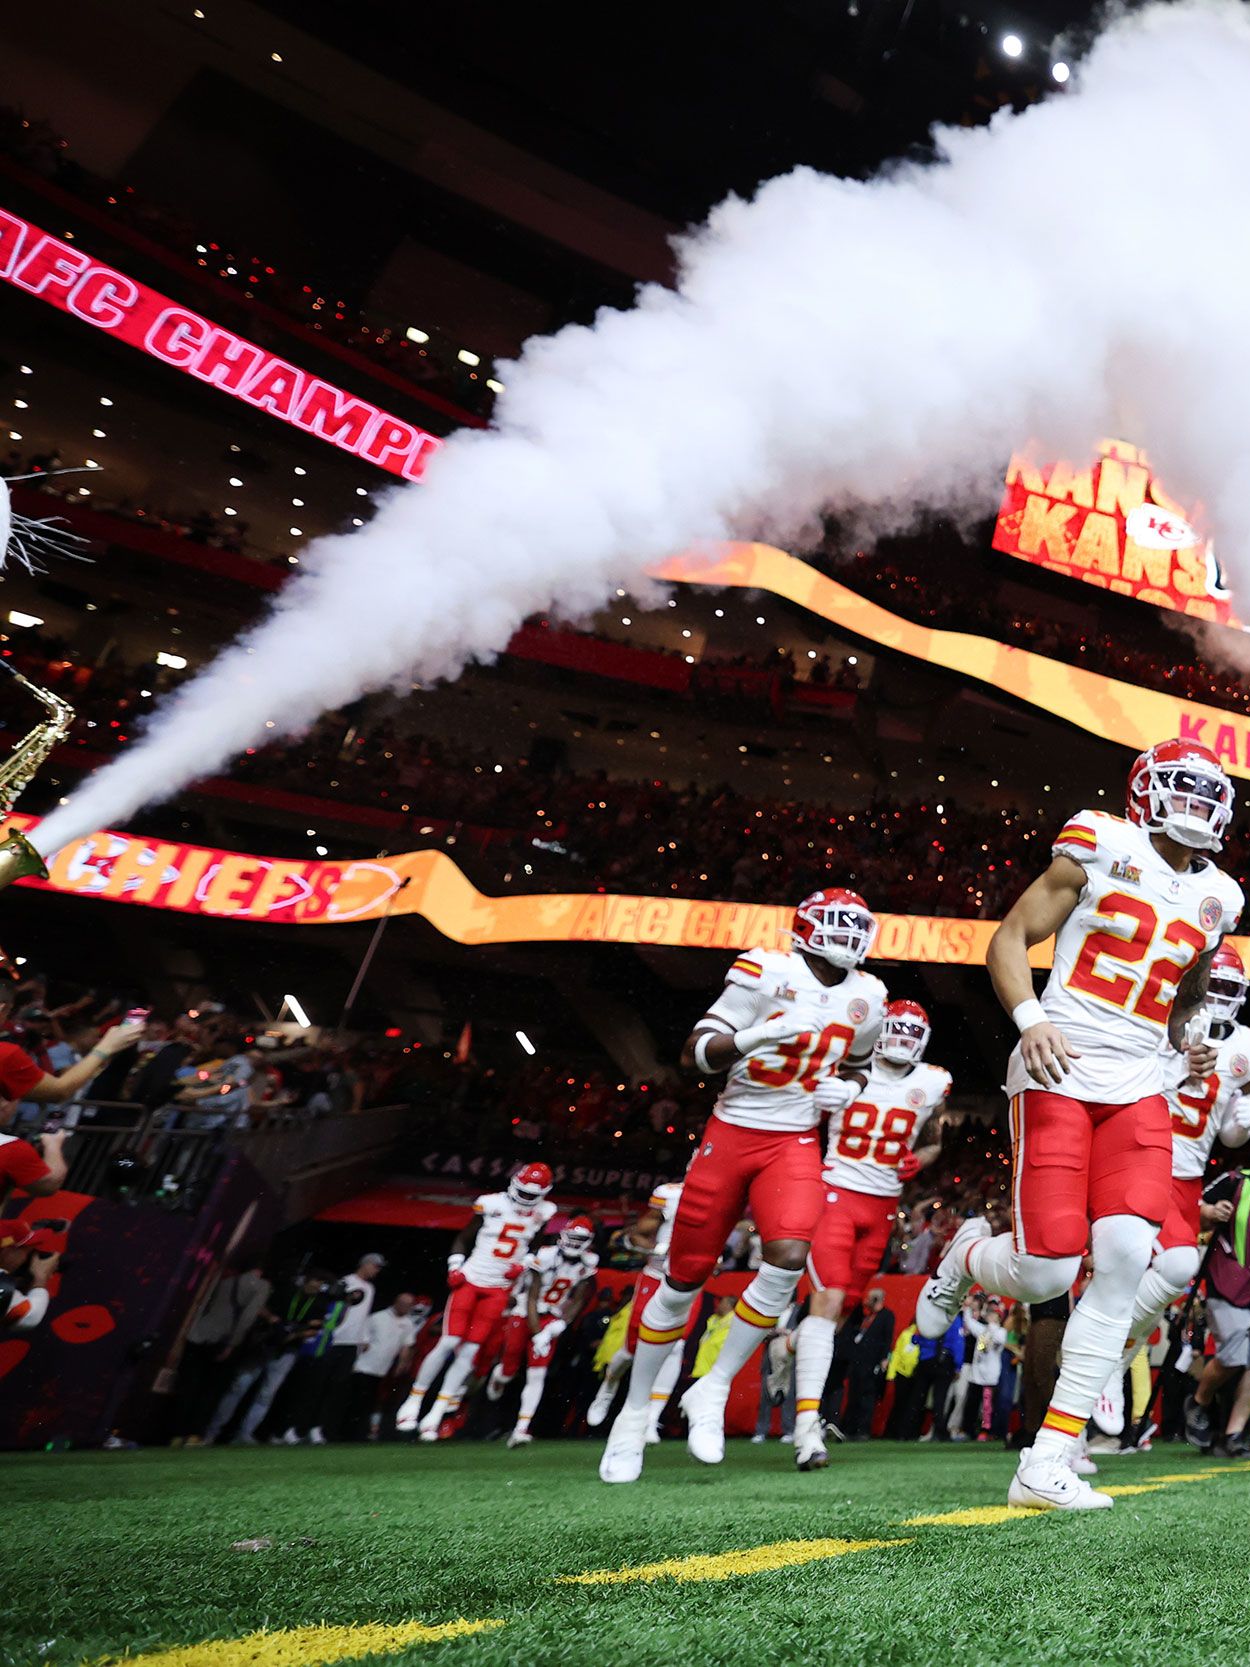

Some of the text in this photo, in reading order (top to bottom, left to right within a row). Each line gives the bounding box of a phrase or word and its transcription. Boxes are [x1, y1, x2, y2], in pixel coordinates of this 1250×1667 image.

[47, 830, 343, 920] CHIEFS
[570, 897, 978, 964] AFC CHAONS
[1063, 891, 1207, 1028] 22
[420, 1152, 567, 1184] CAESS
[836, 1101, 918, 1168] 88
[493, 1222, 526, 1260] 5
[543, 1278, 572, 1305] 8
